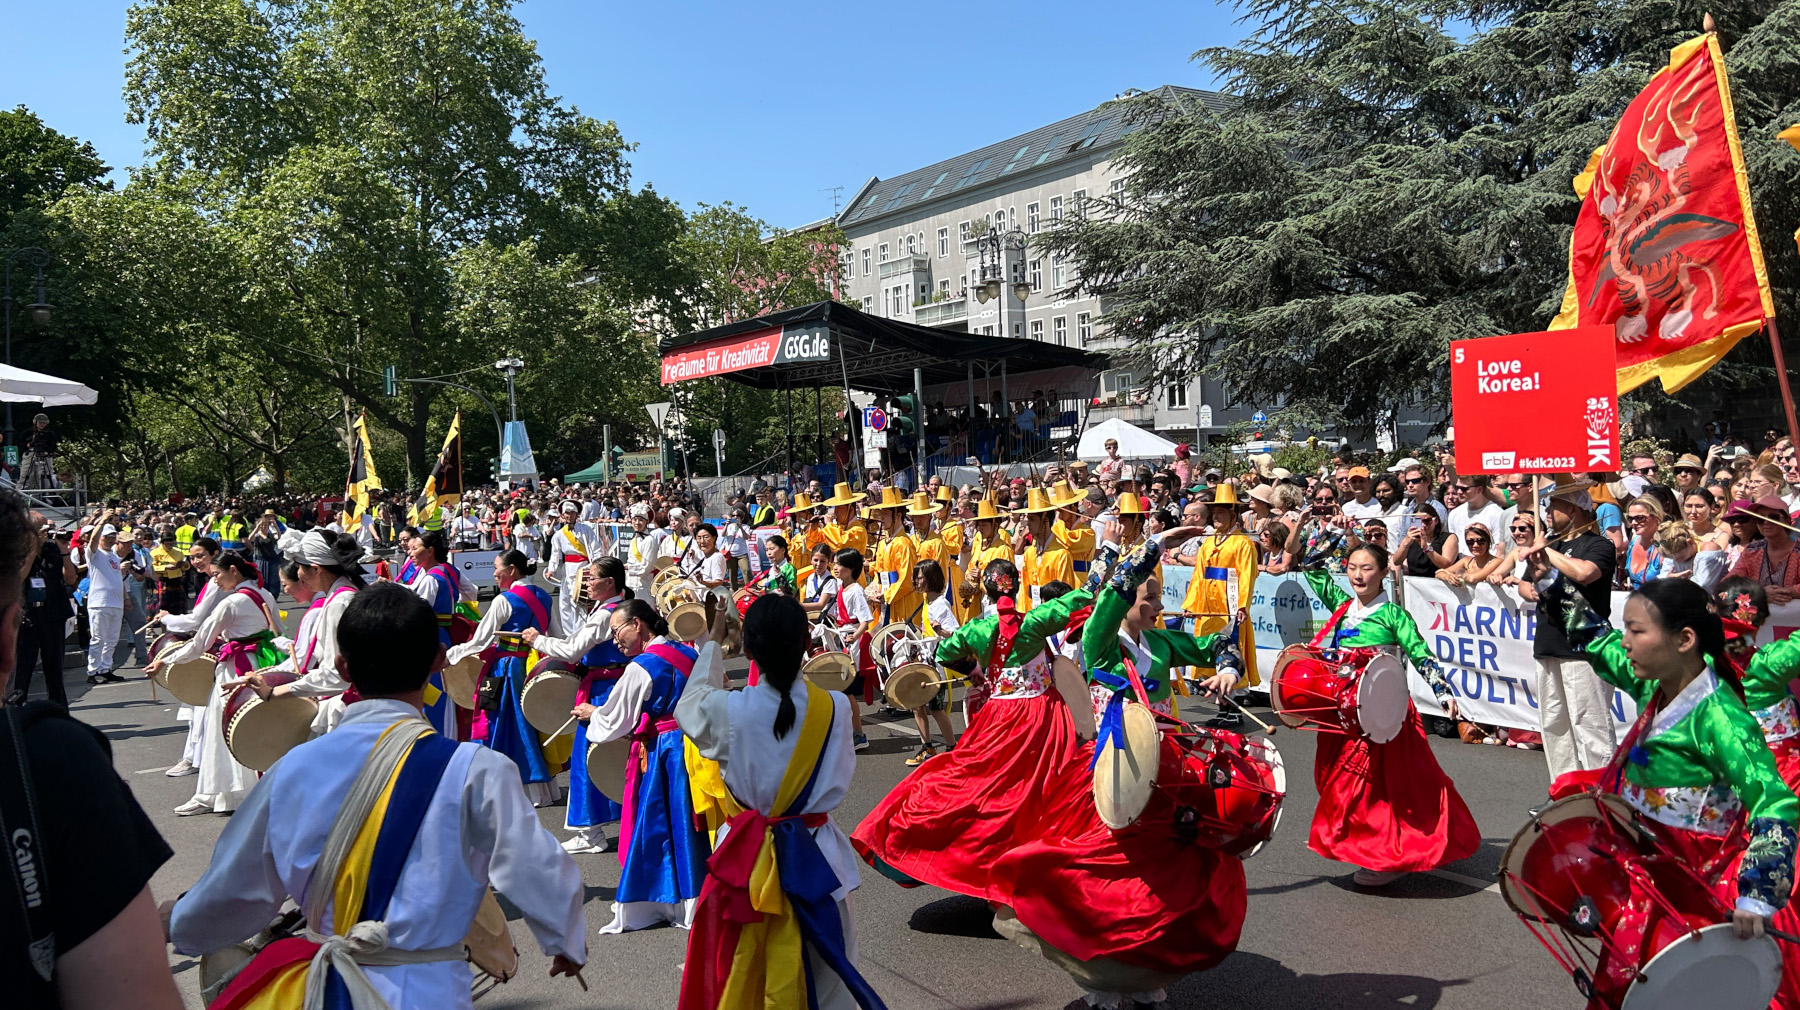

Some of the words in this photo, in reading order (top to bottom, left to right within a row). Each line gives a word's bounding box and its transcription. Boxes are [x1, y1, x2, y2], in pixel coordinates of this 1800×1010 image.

[706, 350, 720, 372] für
[721, 341, 770, 370] Kreativität
[784, 333, 829, 359] GSG.de
[1455, 348, 1465, 363] 5
[1477, 359, 1522, 376] Love
[1478, 372, 1540, 394] Korea!
[1586, 397, 1610, 410] 25
[1485, 455, 1511, 466] rbb
[1519, 457, 1576, 469] #kdk2023
[1429, 601, 1537, 641] KARNE
[1435, 634, 1500, 671] DER
[12, 828, 42, 908] Canon
